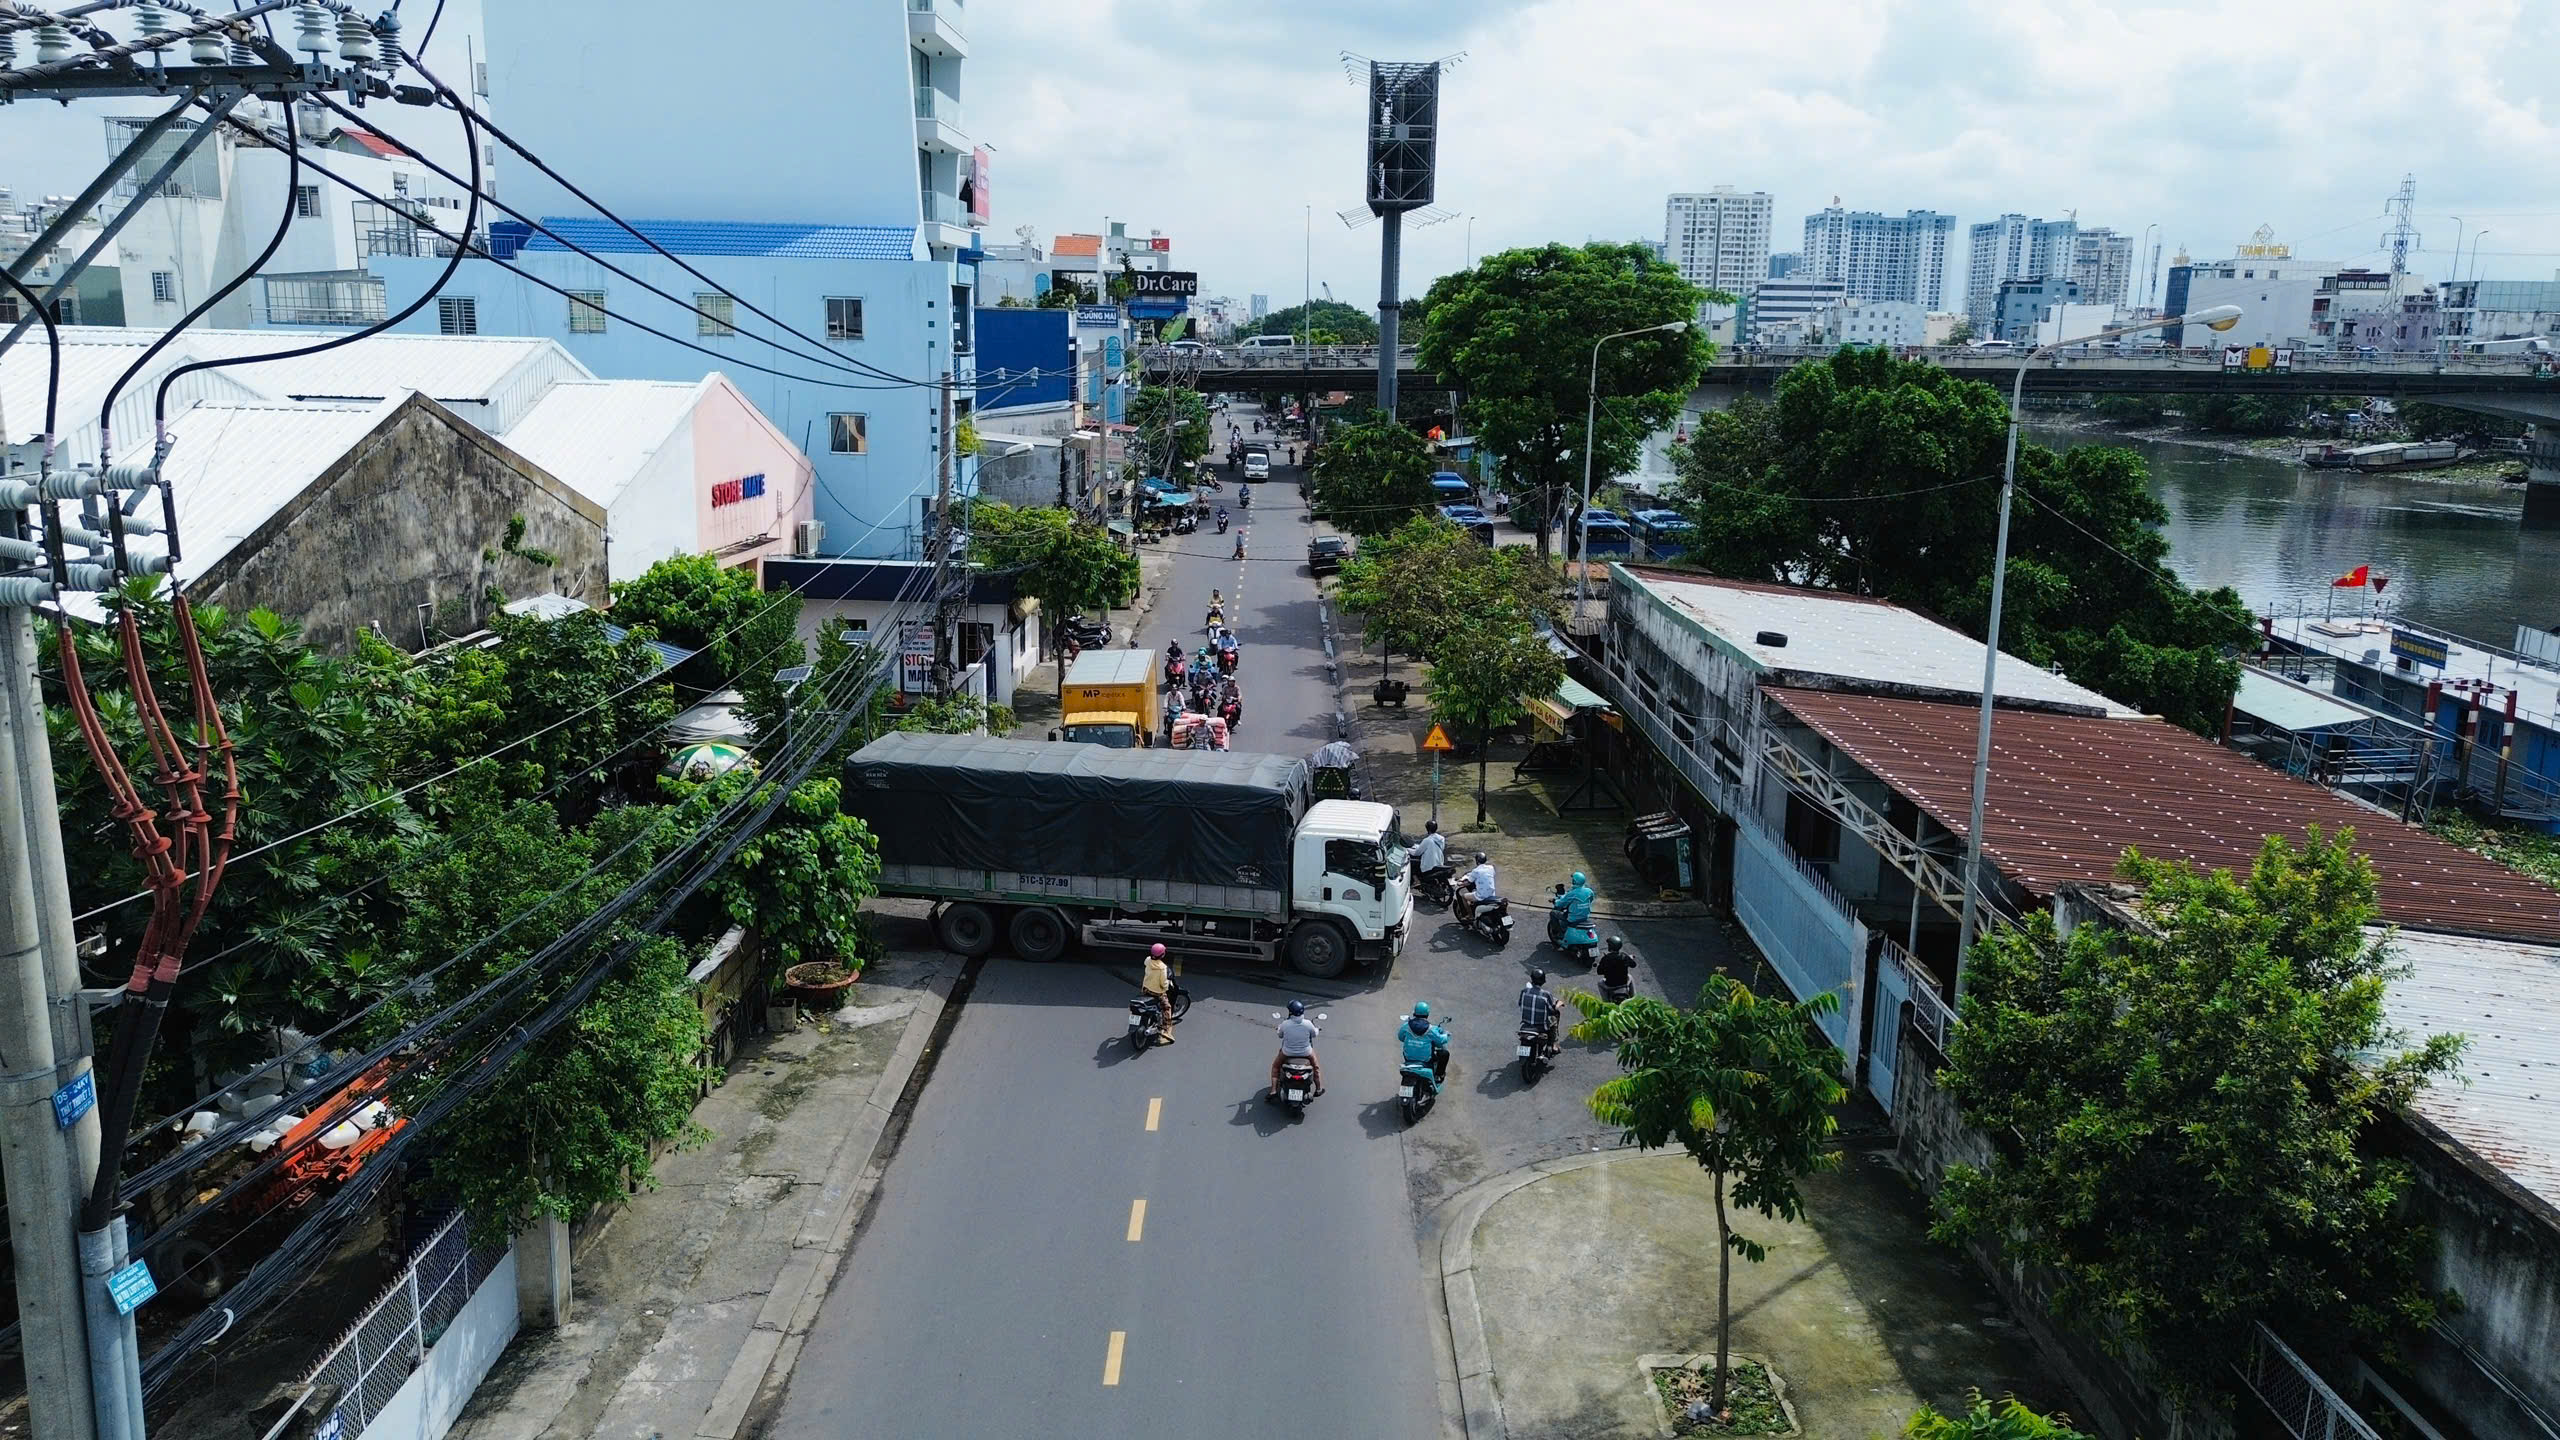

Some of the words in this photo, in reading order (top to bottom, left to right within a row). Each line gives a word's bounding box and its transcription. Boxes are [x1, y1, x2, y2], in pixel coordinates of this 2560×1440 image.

[1137, 275, 1195, 291] Dr.Care
[712, 480, 742, 508] STORE
[743, 473, 765, 500] MATE
[1083, 689, 1100, 698] MP
[56, 1091, 68, 1105] DS
